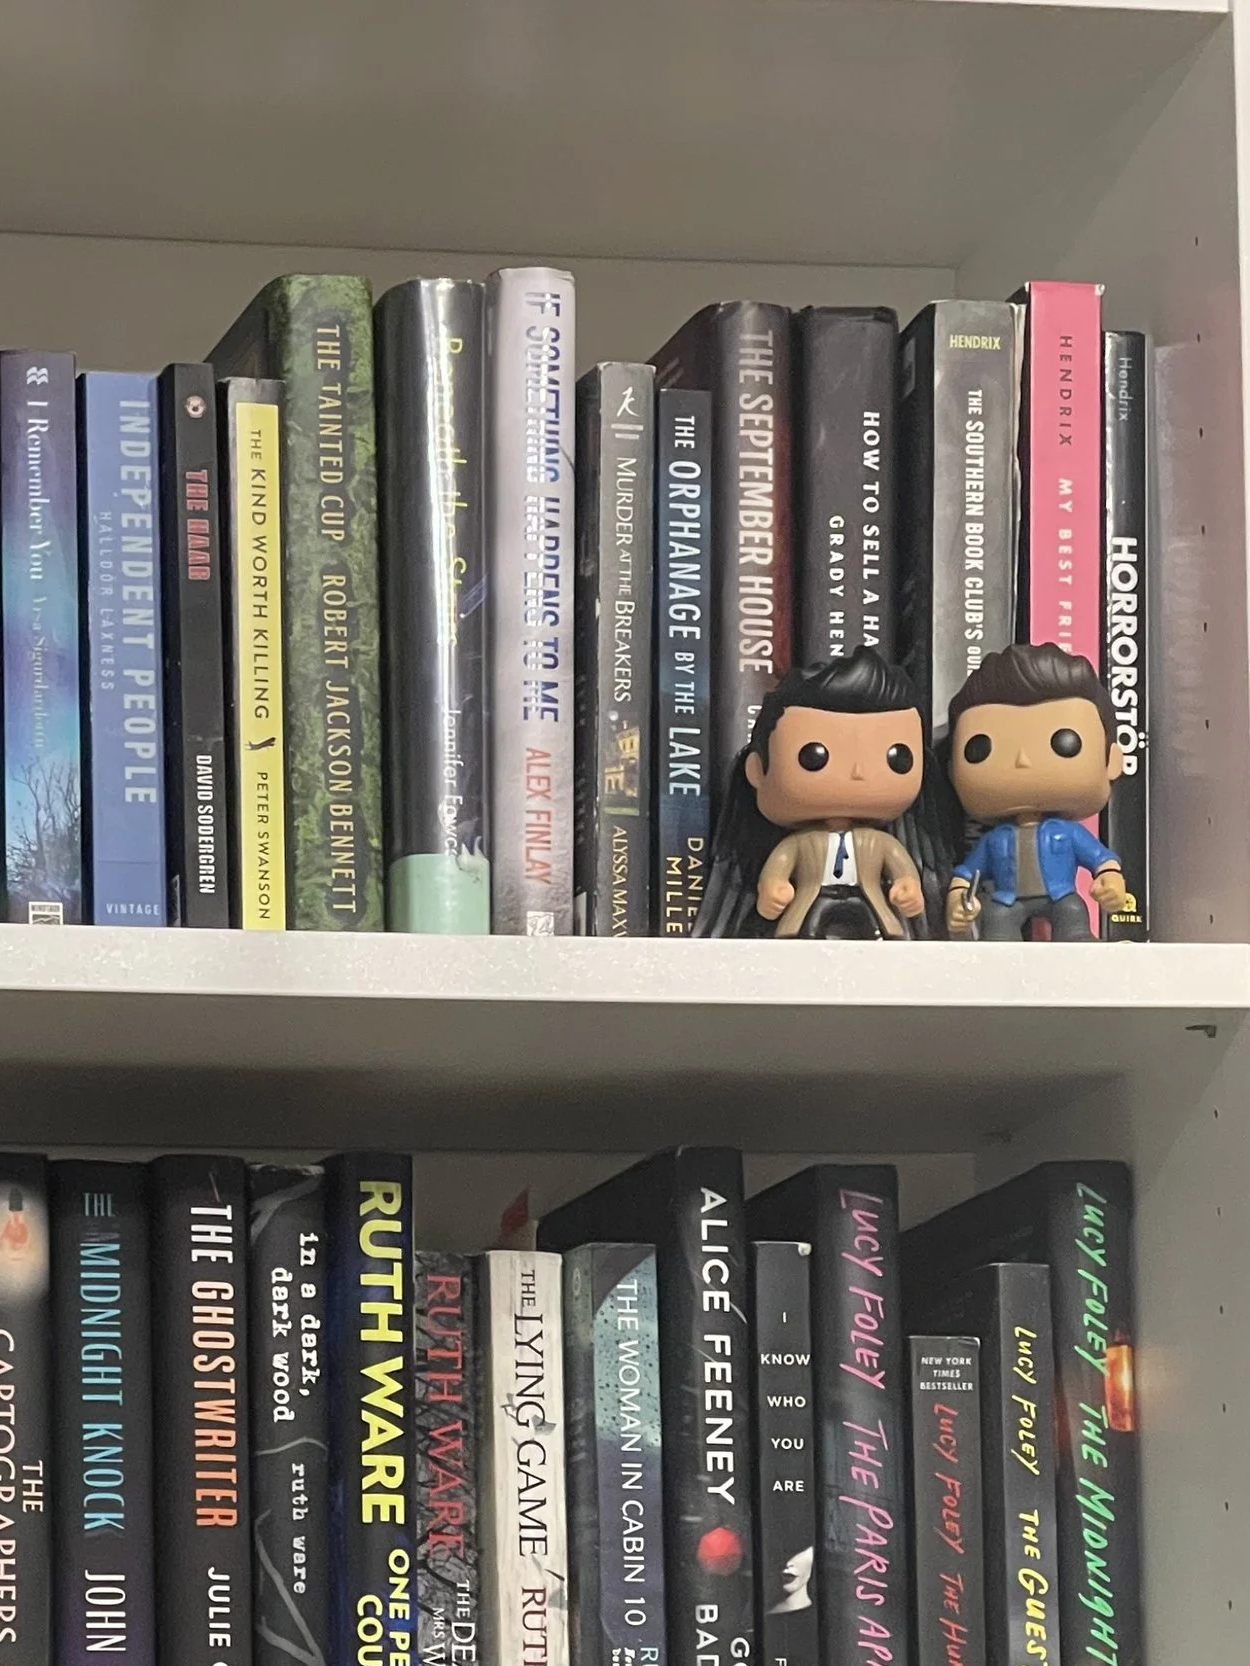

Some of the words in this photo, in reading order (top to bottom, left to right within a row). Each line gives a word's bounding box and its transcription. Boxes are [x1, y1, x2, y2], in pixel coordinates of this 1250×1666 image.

[317, 325, 339, 370] THE
[949, 334, 1001, 350] HENDRIX
[251, 430, 261, 460] THE
[318, 383, 343, 484] TAINTED
[675, 416, 695, 449] THE
[119, 401, 154, 650] INDEPENDENT
[251, 469, 266, 525] KIND
[321, 495, 345, 541] CUP
[252, 537, 267, 618] WORTH
[668, 460, 701, 640] ORPHANAGE
[322, 574, 348, 669] ROBERT
[253, 628, 268, 719] KILLING
[675, 652, 695, 674] BY
[675, 681, 695, 715] THE
[123, 669, 157, 803] PEOPLE
[326, 680, 352, 793] JACKSON
[669, 727, 700, 796] LAKE
[196, 755, 213, 800] DAVID
[257, 772, 267, 824] PETER
[197, 805, 214, 893] SODERGREN
[258, 831, 270, 919] SWANSON
[329, 804, 356, 913] BENNETT
[106, 904, 159, 916] VINTAGE
[190, 1204, 233, 1264] THE
[359, 1180, 403, 1343] RUTH
[700, 1187, 730, 1313] ALICE
[80, 1242, 123, 1406] MIDNIGHT
[520, 1269, 535, 1307] THE
[514, 1314, 546, 1427] LYING
[760, 1354, 810, 1366] KNOW
[919, 1382, 973, 1390] BESTSELLER
[921, 1357, 944, 1365] NEW
[946, 1357, 971, 1366] YORK
[933, 1370, 961, 1378] TIMES
[192, 1280, 237, 1527] GHOSTWRITER
[360, 1356, 406, 1524] WARE
[703, 1334, 735, 1505] FEENEY
[767, 1396, 806, 1408] WHO
[83, 1423, 125, 1530] KNOCK
[771, 1438, 804, 1449] YOU
[517, 1441, 548, 1556] GAME
[772, 1480, 804, 1491] ARE
[85, 1569, 127, 1652] JOHN
[207, 1566, 231, 1648] JULIE
[388, 1548, 410, 1621] ONE
